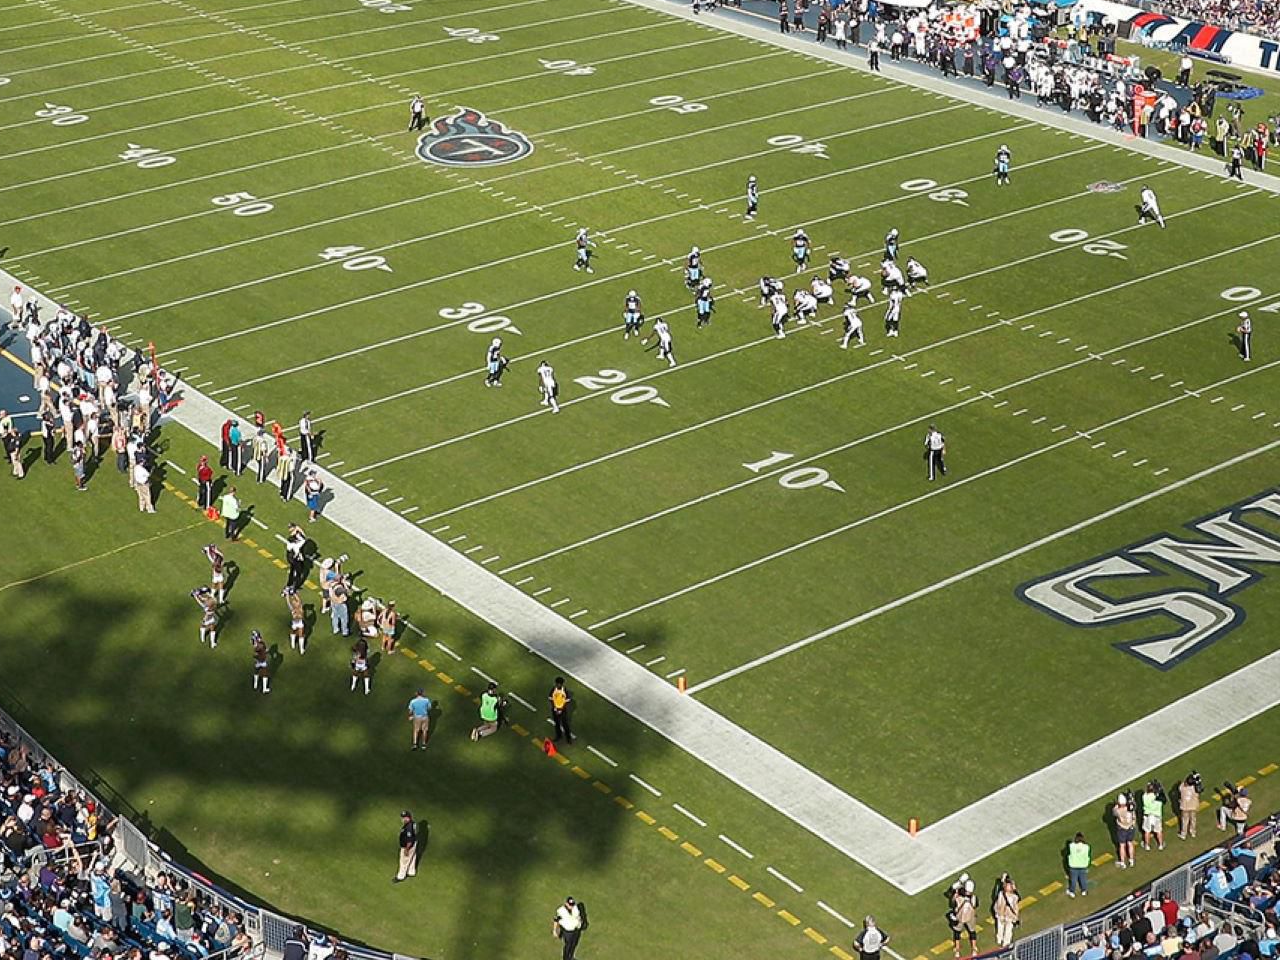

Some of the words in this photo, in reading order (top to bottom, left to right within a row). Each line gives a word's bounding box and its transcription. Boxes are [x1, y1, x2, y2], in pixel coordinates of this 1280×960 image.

[35, 103, 89, 126] 30
[648, 95, 709, 114] 50
[119, 146, 177, 169] 40
[767, 134, 826, 157] 40
[900, 178, 967, 203] 30
[210, 191, 275, 216] 50
[1049, 227, 1124, 258] 20
[319, 244, 385, 271] 40
[438, 301, 514, 334] 30
[573, 368, 660, 406] 20
[743, 450, 834, 490] 10
